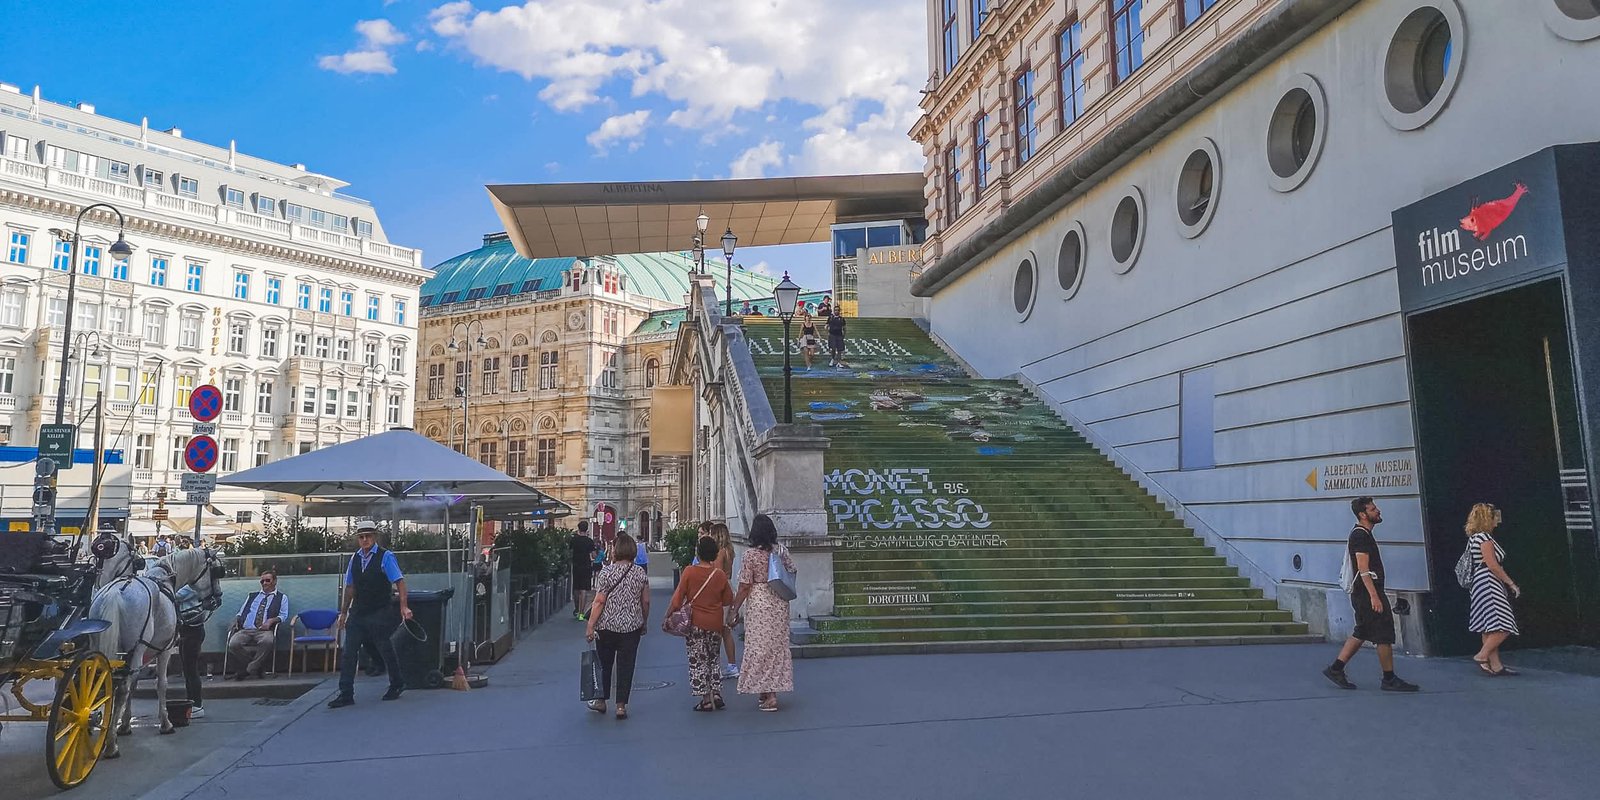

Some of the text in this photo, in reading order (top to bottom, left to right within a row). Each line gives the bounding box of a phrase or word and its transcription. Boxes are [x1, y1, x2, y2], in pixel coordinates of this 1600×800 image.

[602, 184, 664, 194] ALBERTINA
[1418, 227, 1461, 262] film
[1421, 234, 1528, 287] museum
[211, 306, 221, 356] HOTEL
[194, 425, 213, 434] Anfang
[1324, 459, 1412, 476] ALBERTINA MUSEUM
[823, 468, 969, 495] MONET BIS
[1323, 475, 1412, 491] SAMMLUNG BATLINER
[190, 494, 206, 503] Ende
[828, 498, 993, 530] PICASSO
[842, 534, 1009, 548] DIE SAMMLUNG BATLINER
[868, 593, 930, 605] DOROTHEUM
